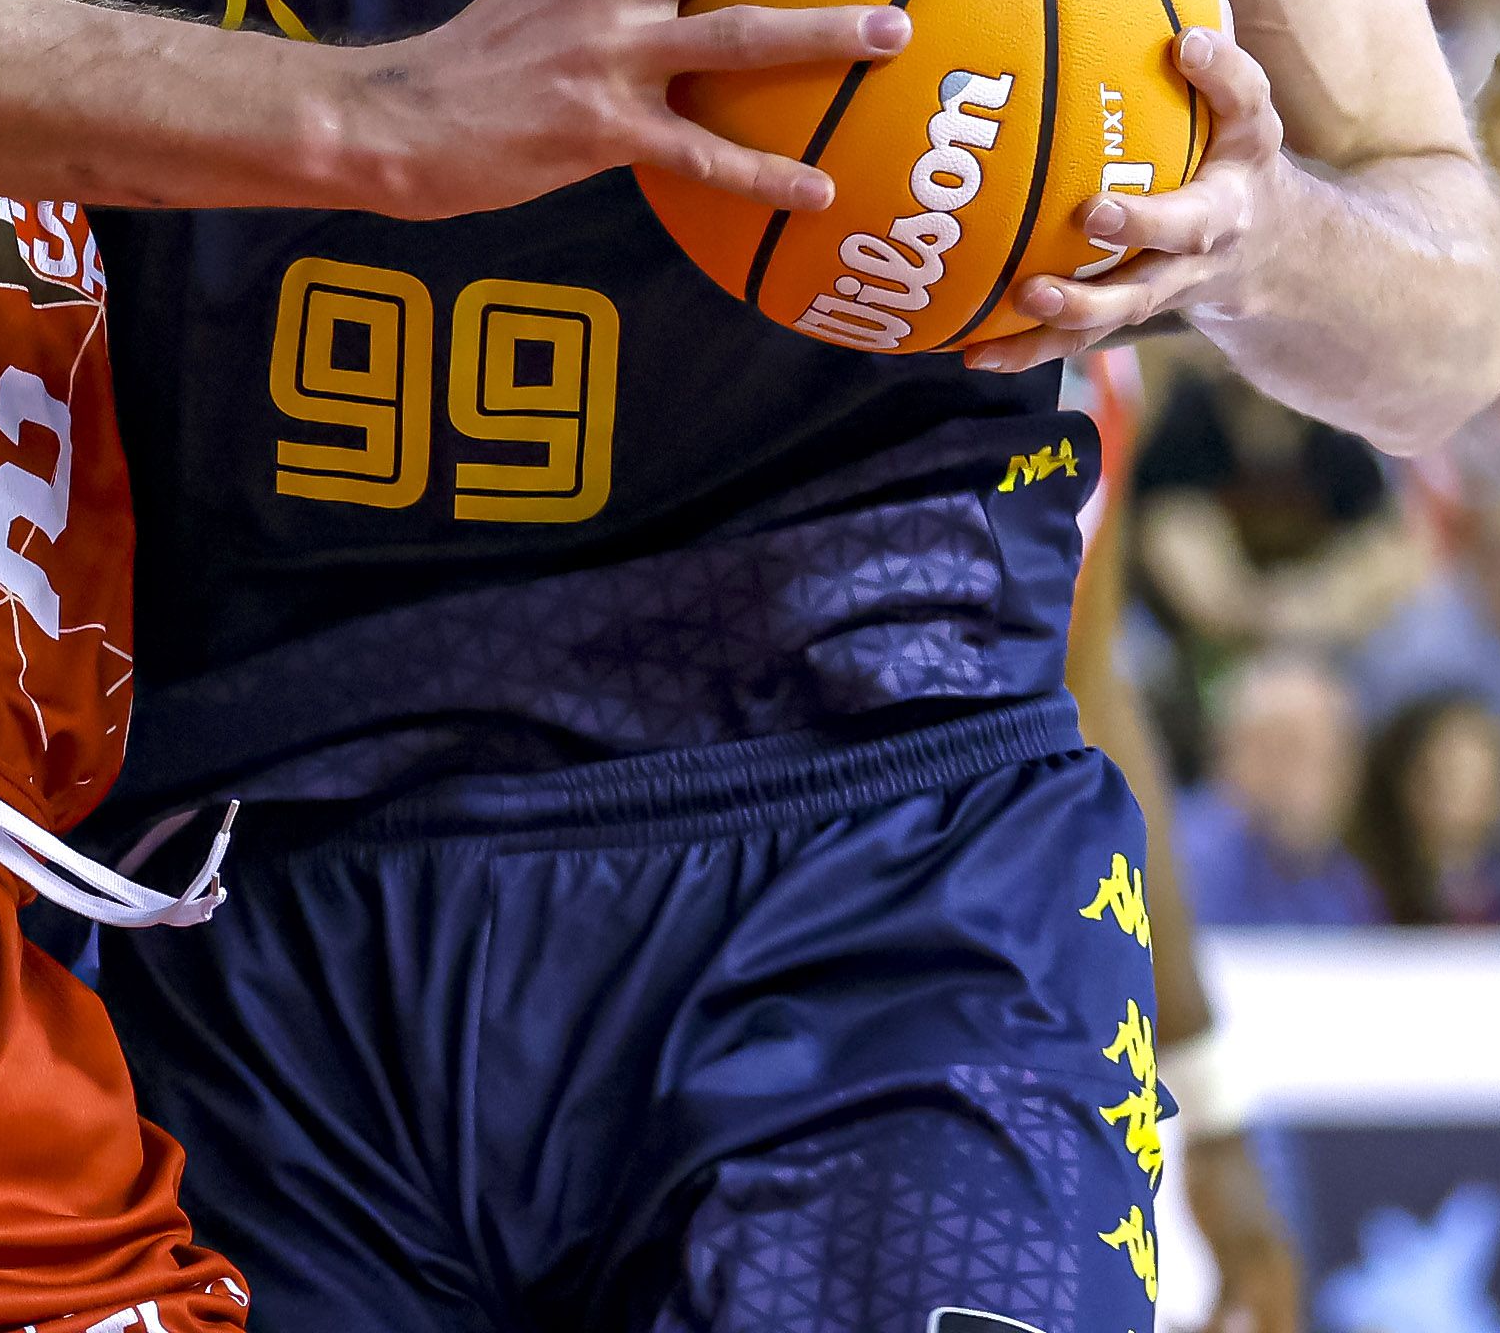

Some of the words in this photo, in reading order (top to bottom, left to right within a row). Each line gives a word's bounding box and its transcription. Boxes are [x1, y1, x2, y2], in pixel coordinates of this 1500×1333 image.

[793, 69, 1017, 350] Wilson
[1099, 81, 1125, 157] NXT
[269, 256, 620, 524] 99
